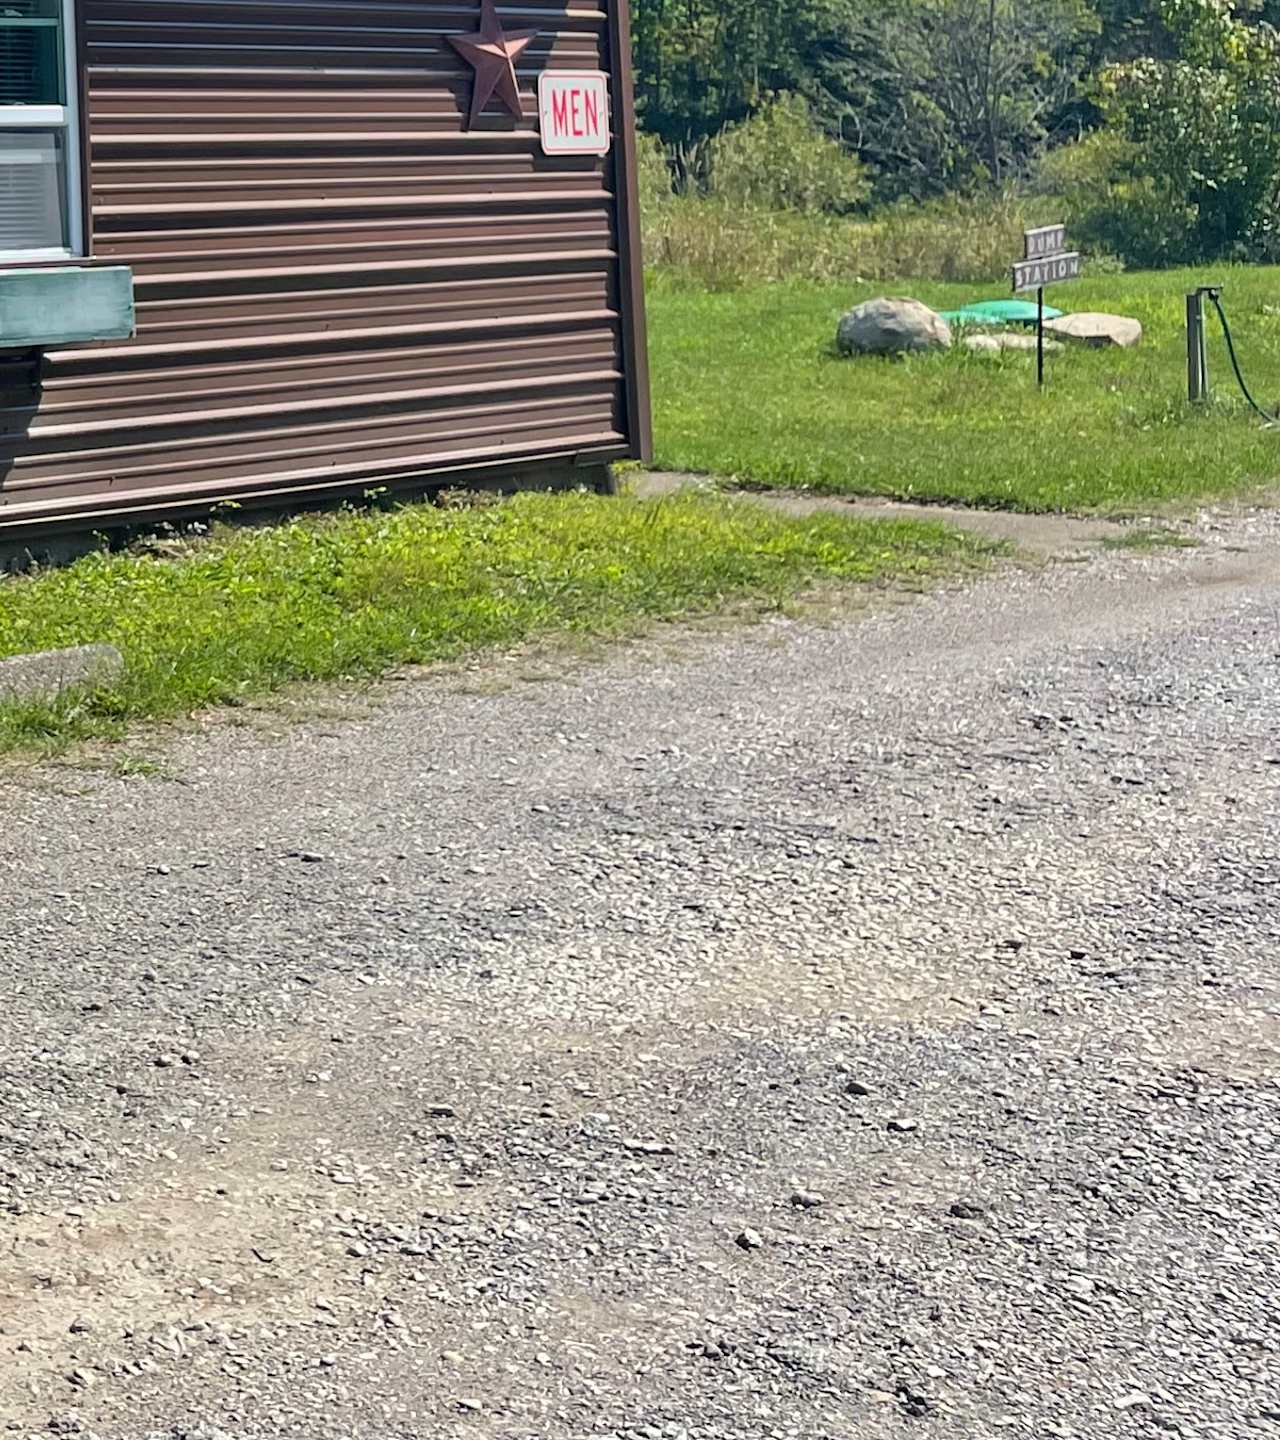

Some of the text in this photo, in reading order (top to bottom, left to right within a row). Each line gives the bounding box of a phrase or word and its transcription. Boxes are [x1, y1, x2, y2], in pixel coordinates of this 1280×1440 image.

[552, 89, 598, 137] MEN
[1028, 230, 1064, 253] DUMP
[1016, 260, 1078, 286] STATION
